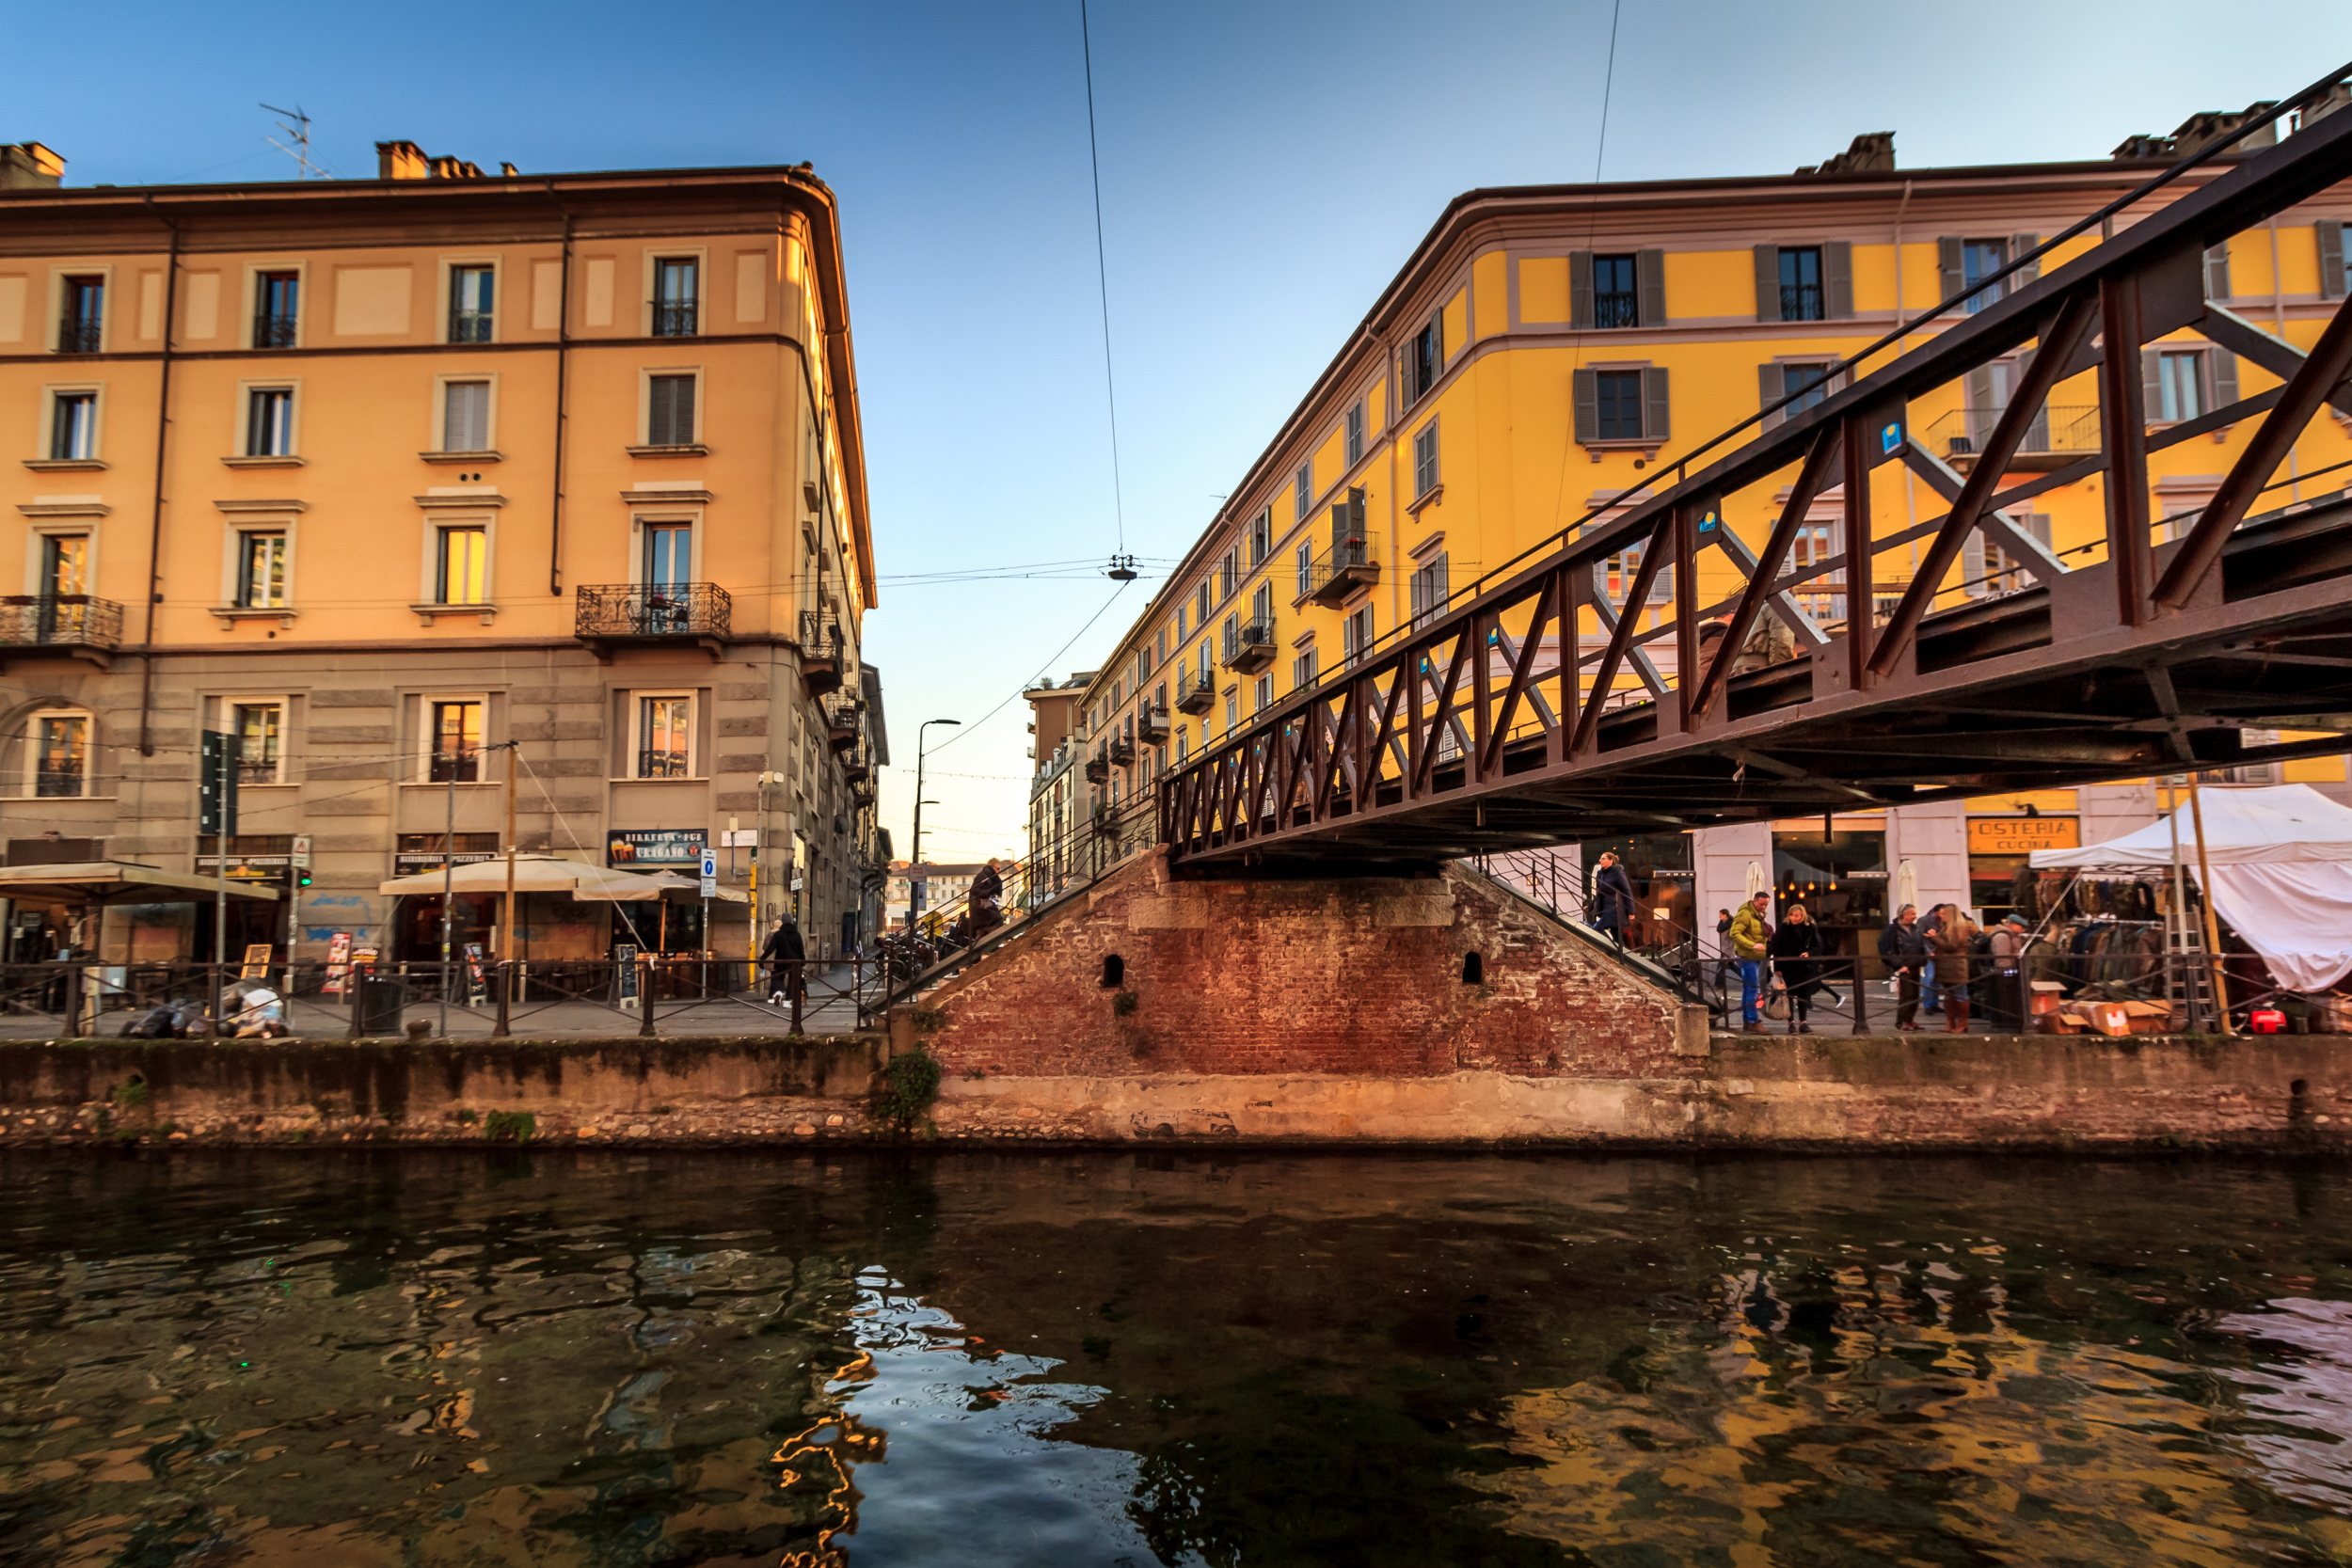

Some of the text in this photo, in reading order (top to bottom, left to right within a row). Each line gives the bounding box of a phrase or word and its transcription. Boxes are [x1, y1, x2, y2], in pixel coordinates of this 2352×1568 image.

[1979, 822, 2068, 835] OSTERIA
[626, 832, 703, 842] BIRRERIA PUB
[1996, 841, 2053, 849] CUCINA
[635, 847, 684, 858] URAGANO
